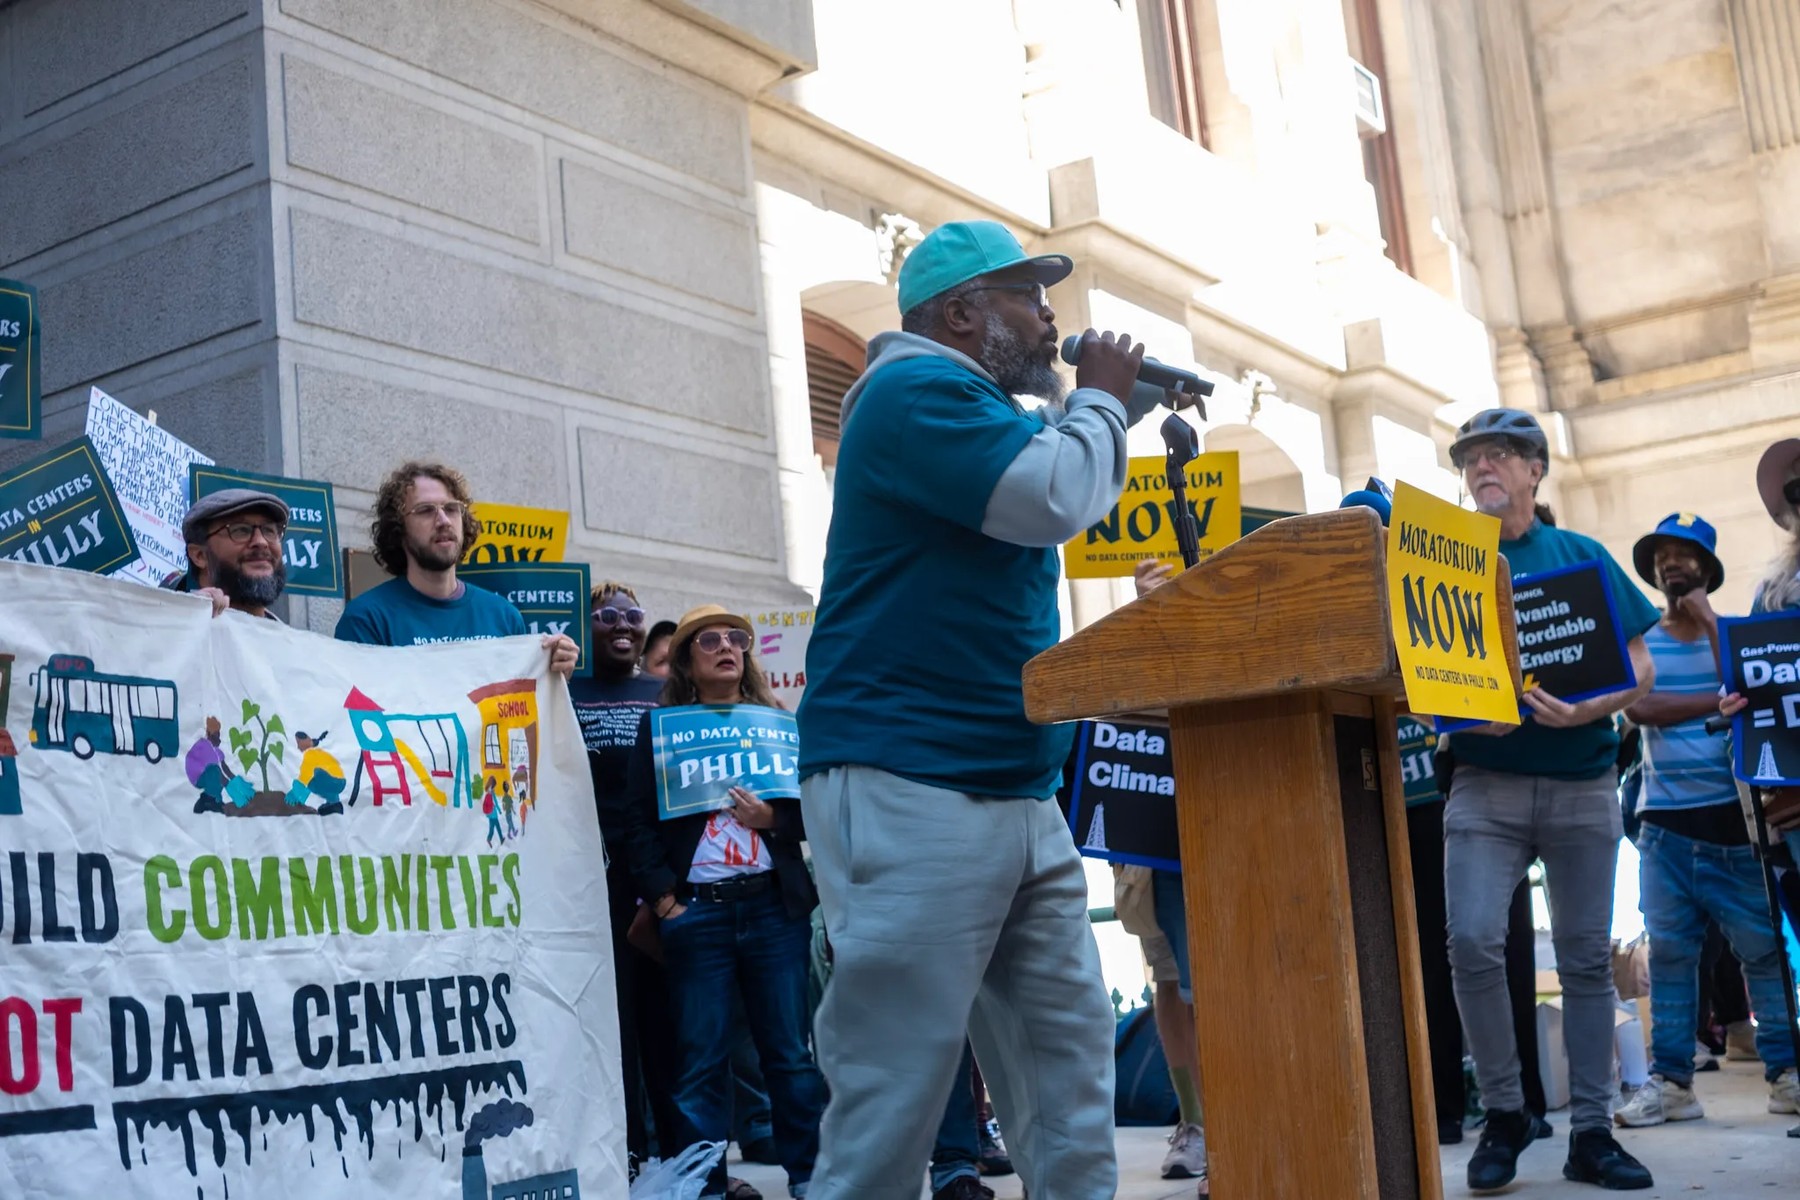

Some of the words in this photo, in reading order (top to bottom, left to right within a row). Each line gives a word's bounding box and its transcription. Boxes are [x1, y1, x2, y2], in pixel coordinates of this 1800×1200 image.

[90, 419, 105, 437] TO
[91, 404, 127, 436] THEIR
[132, 430, 182, 471] THINKING
[141, 421, 168, 447] MEN
[27, 473, 92, 515] CENTERS
[27, 519, 42, 535] IN
[1085, 496, 1219, 546] NOW
[1399, 520, 1487, 577] MORATORIUM
[507, 590, 575, 604] CENTERS
[1401, 571, 1488, 661] NOW
[1519, 643, 1584, 670] Energy
[497, 700, 529, 718] SCHOOL
[672, 730, 696, 745] NO
[701, 726, 742, 741] DATA
[747, 726, 799, 743] CENTE
[740, 738, 753, 749] IN
[1093, 722, 1166, 756] Data
[1088, 760, 1175, 796] Clima
[0, 851, 119, 944] ILD
[144, 852, 522, 943] COMMUNITIES
[109, 991, 274, 1087] DATA
[292, 972, 517, 1070] CENTERS
